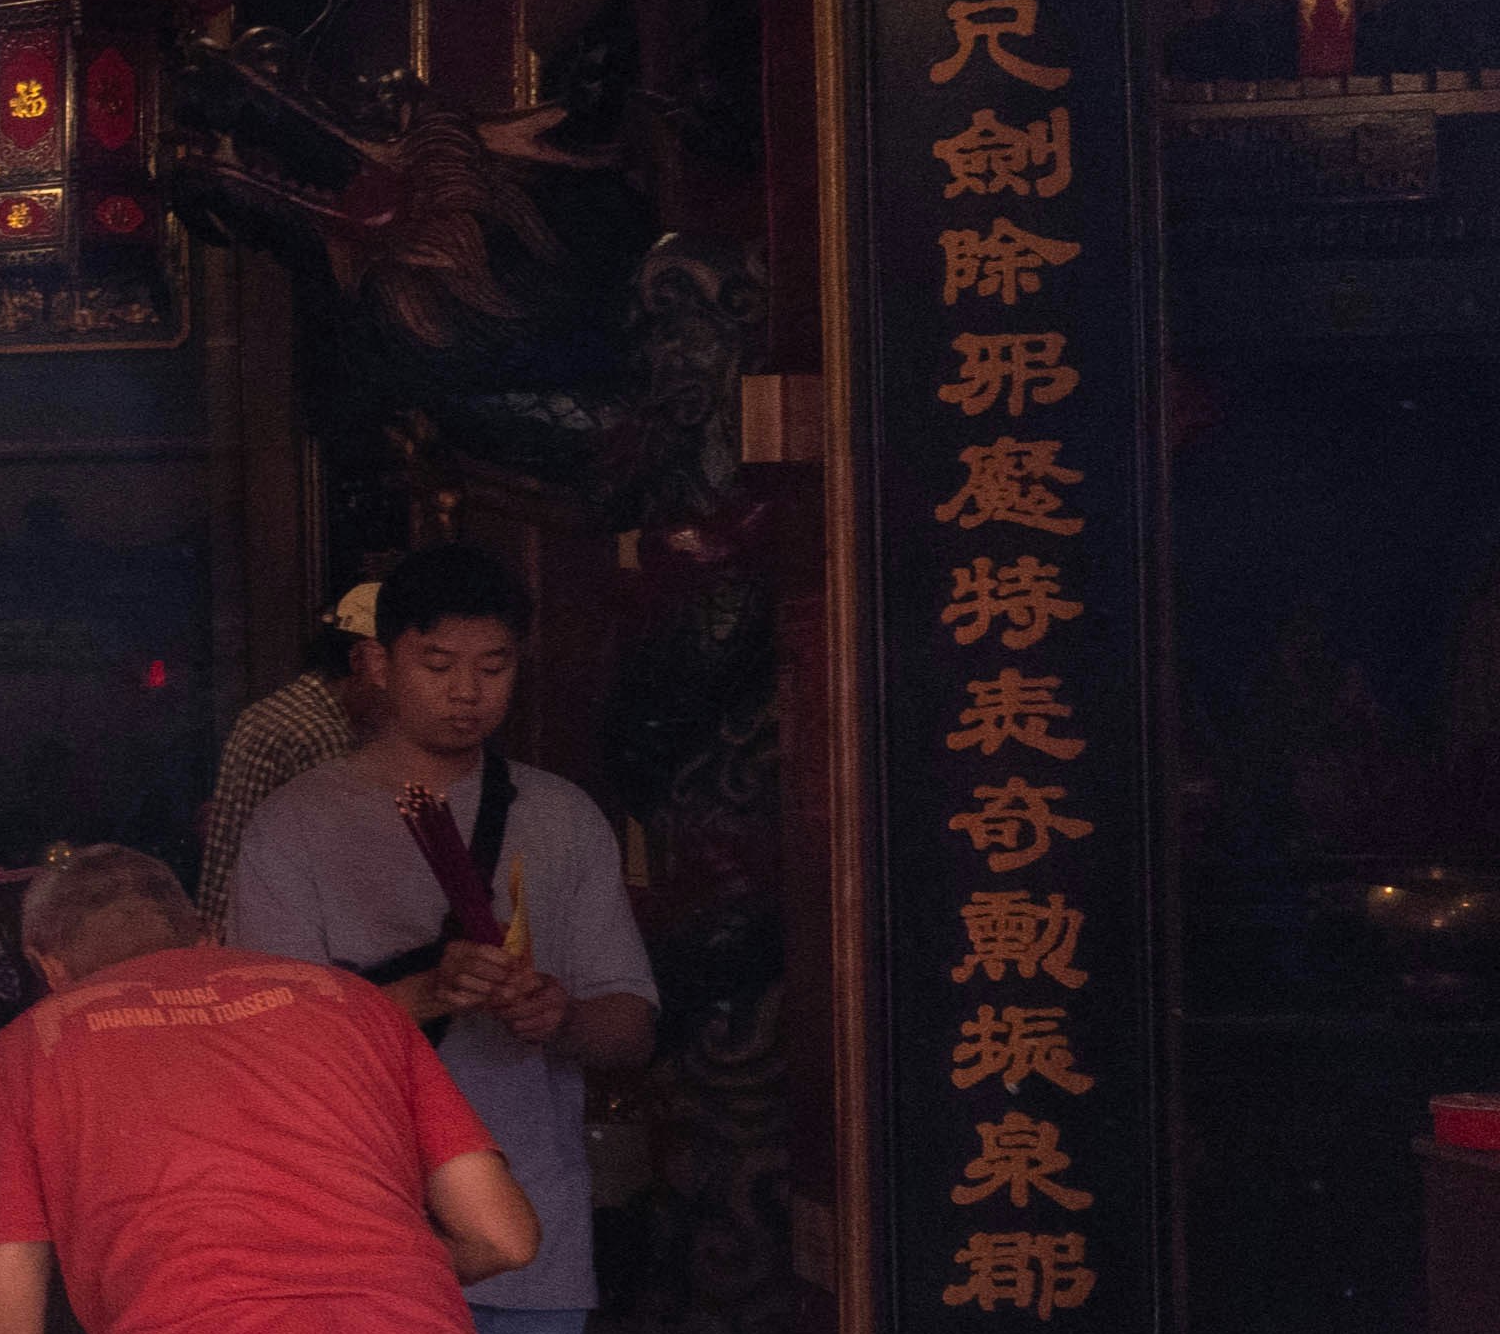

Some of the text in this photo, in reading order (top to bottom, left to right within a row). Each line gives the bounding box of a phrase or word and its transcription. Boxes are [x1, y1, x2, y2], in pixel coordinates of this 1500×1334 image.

[9, 78, 49, 120] 福
[5, 200, 33, 232] 福
[151, 986, 220, 1006] VIHARA
[87, 1008, 167, 1032] DHARMA
[168, 1006, 213, 1027] JAYA
